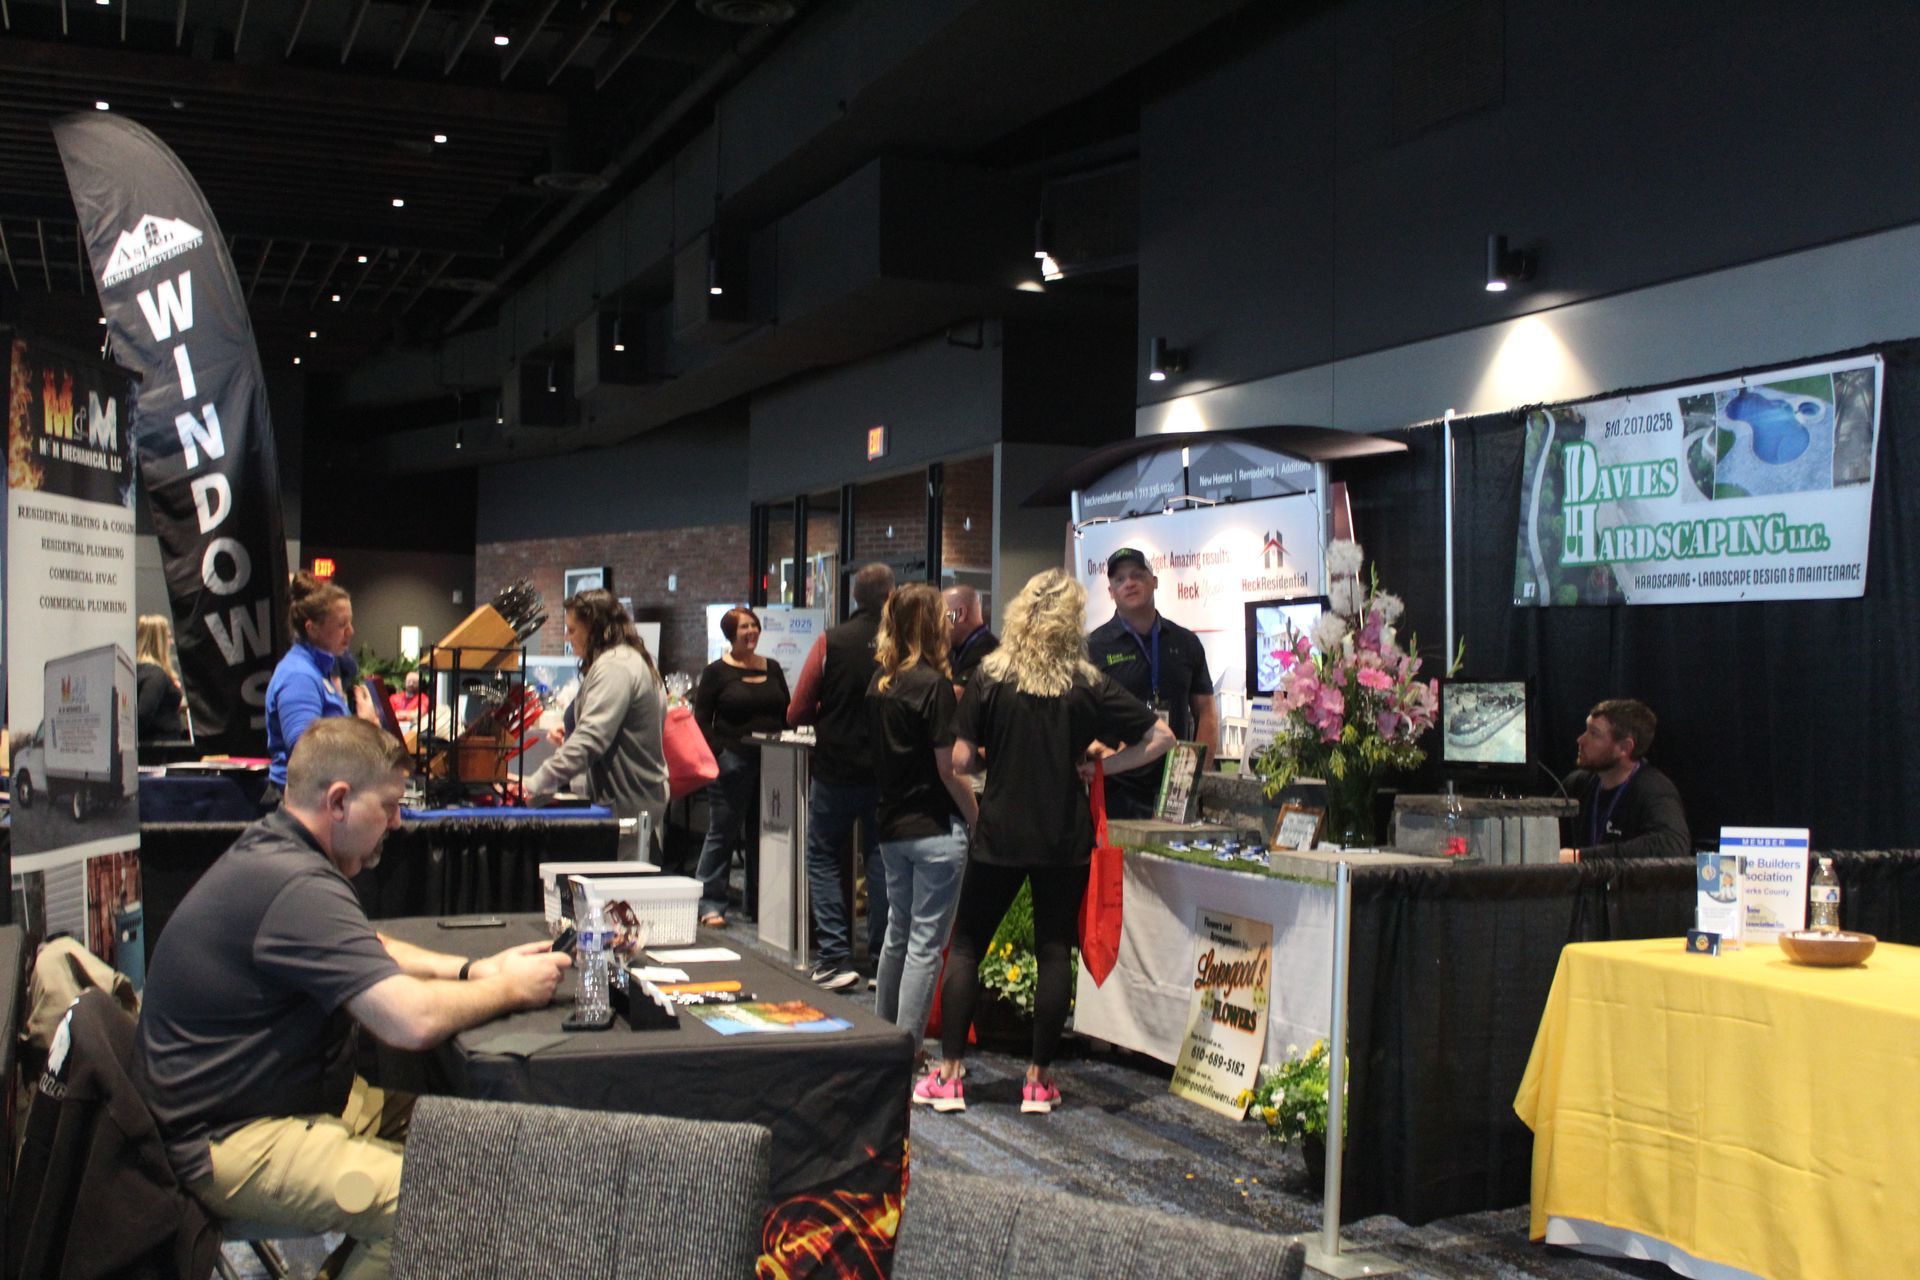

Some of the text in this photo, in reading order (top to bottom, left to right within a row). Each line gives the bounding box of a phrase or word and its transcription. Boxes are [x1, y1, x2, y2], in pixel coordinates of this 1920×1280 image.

[117, 232, 174, 265] Aspen
[103, 236, 203, 288] HOME IMPROVEMENTS
[62, 443, 108, 471] MECHANICAL
[110, 455, 122, 473] LLC
[1200, 462, 1311, 487] New Homes Remodeling Additions
[1084, 490, 1134, 507] heckresidential.com
[18, 505, 69, 526] RESIDENTIAL
[71, 514, 100, 531] HEATING
[102, 520, 108, 530] &
[41, 536, 124, 560] RESIDENTIAL PLUMBING
[1787, 524, 1830, 550] LLC.
[1169, 550, 1201, 570] Amazing
[49, 566, 117, 585] COMMERCIAL HVAC
[1241, 571, 1308, 592] HeckResidential
[1634, 563, 1861, 590] HARDSCAPING LANDSCAPE DESIGN & MAINTENANCE
[1177, 581, 1200, 600] Heck
[39, 594, 127, 614] COMMERCIAL PLUMBING
[789, 617, 812, 628] 2025
[1741, 838, 1786, 847] MEMBER
[1757, 858, 1801, 869] Builders
[1745, 887, 1790, 898] erks County
[1211, 999, 1258, 1034] FLOWERS
[1191, 1045, 1245, 1077] 610-689-5182
[1174, 1071, 1238, 1107] levengoodsflowers.co
